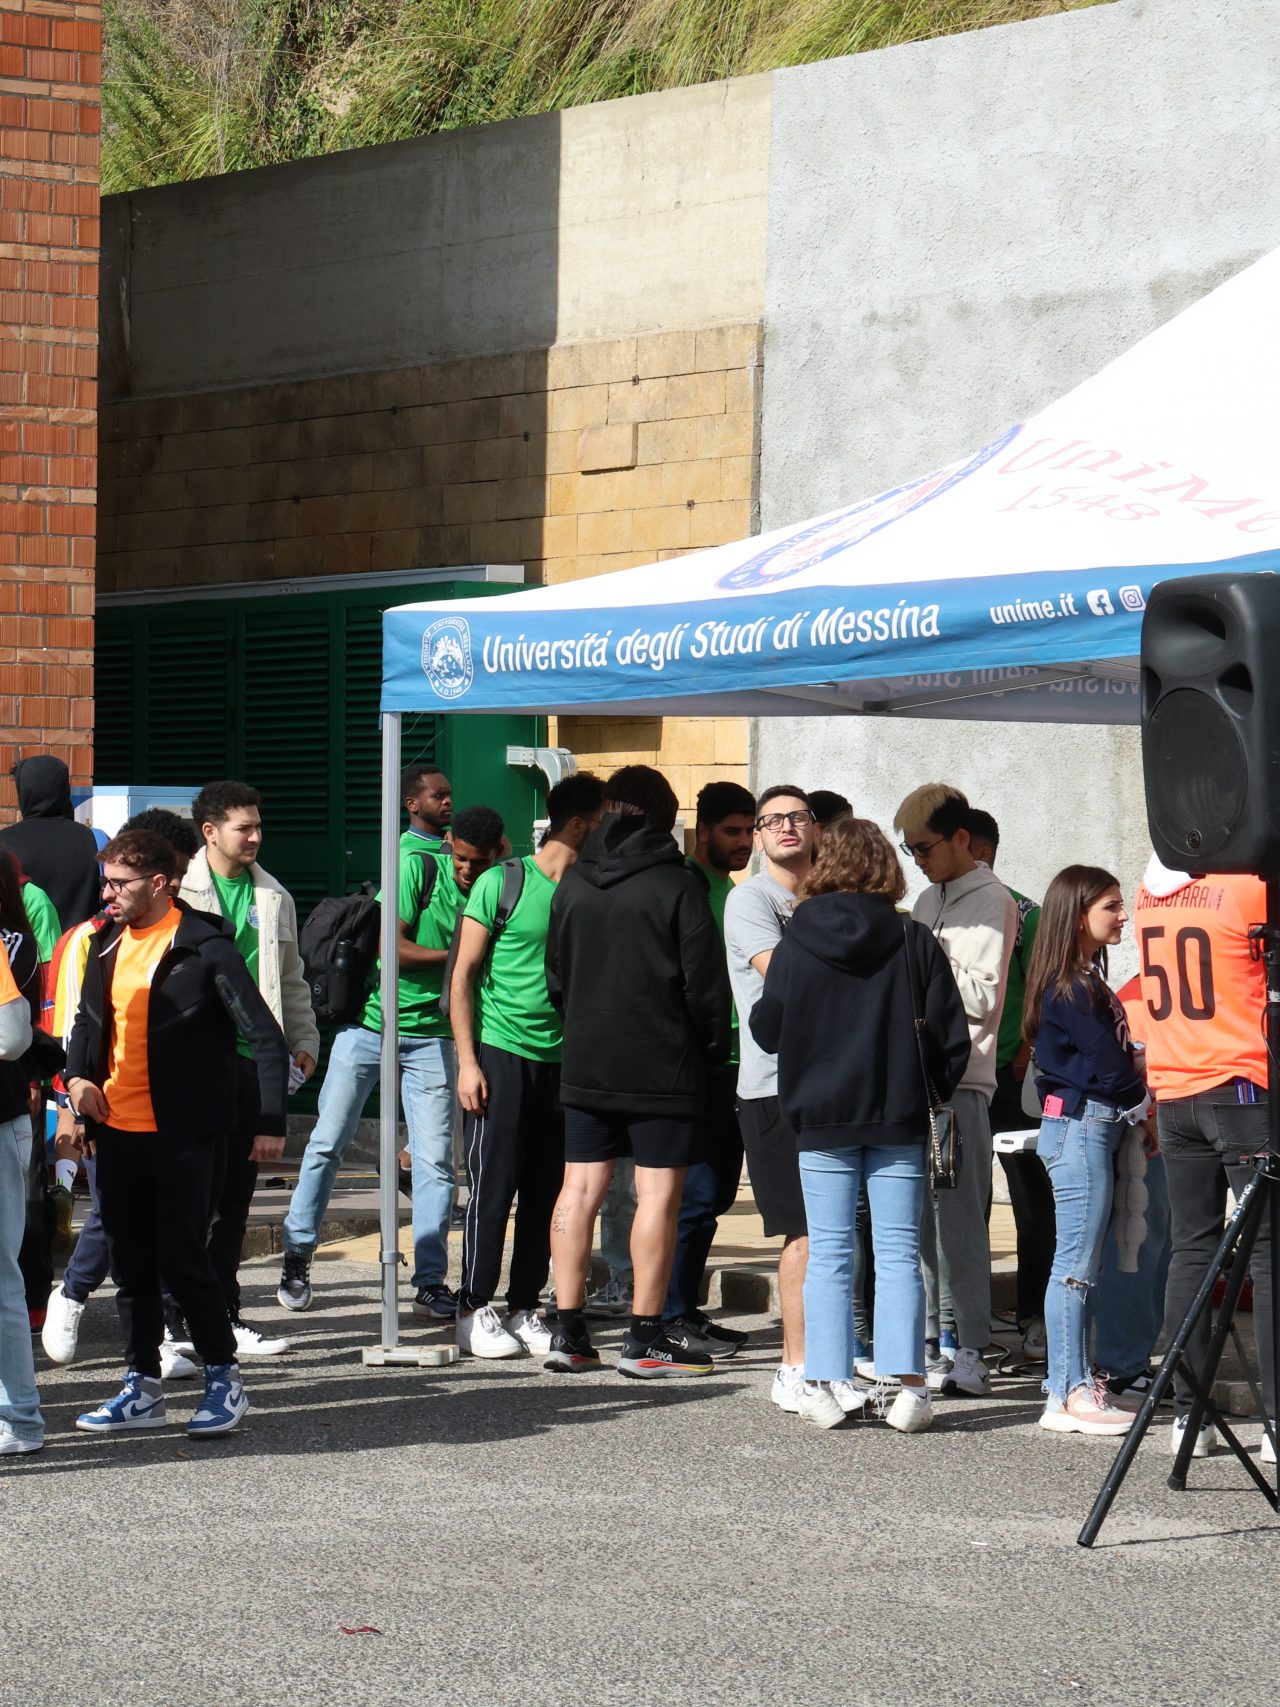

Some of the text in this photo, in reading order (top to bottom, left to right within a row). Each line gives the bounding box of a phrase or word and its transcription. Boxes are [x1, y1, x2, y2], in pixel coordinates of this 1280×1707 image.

[996, 485, 1161, 520] 1548
[989, 592, 1079, 625] unime.it
[616, 622, 691, 671] degli
[691, 615, 775, 659] Studi
[773, 611, 811, 650] di
[810, 599, 941, 647] Messina
[1141, 926, 1216, 1022] 50
[646, 1347, 673, 1362] HOKA
